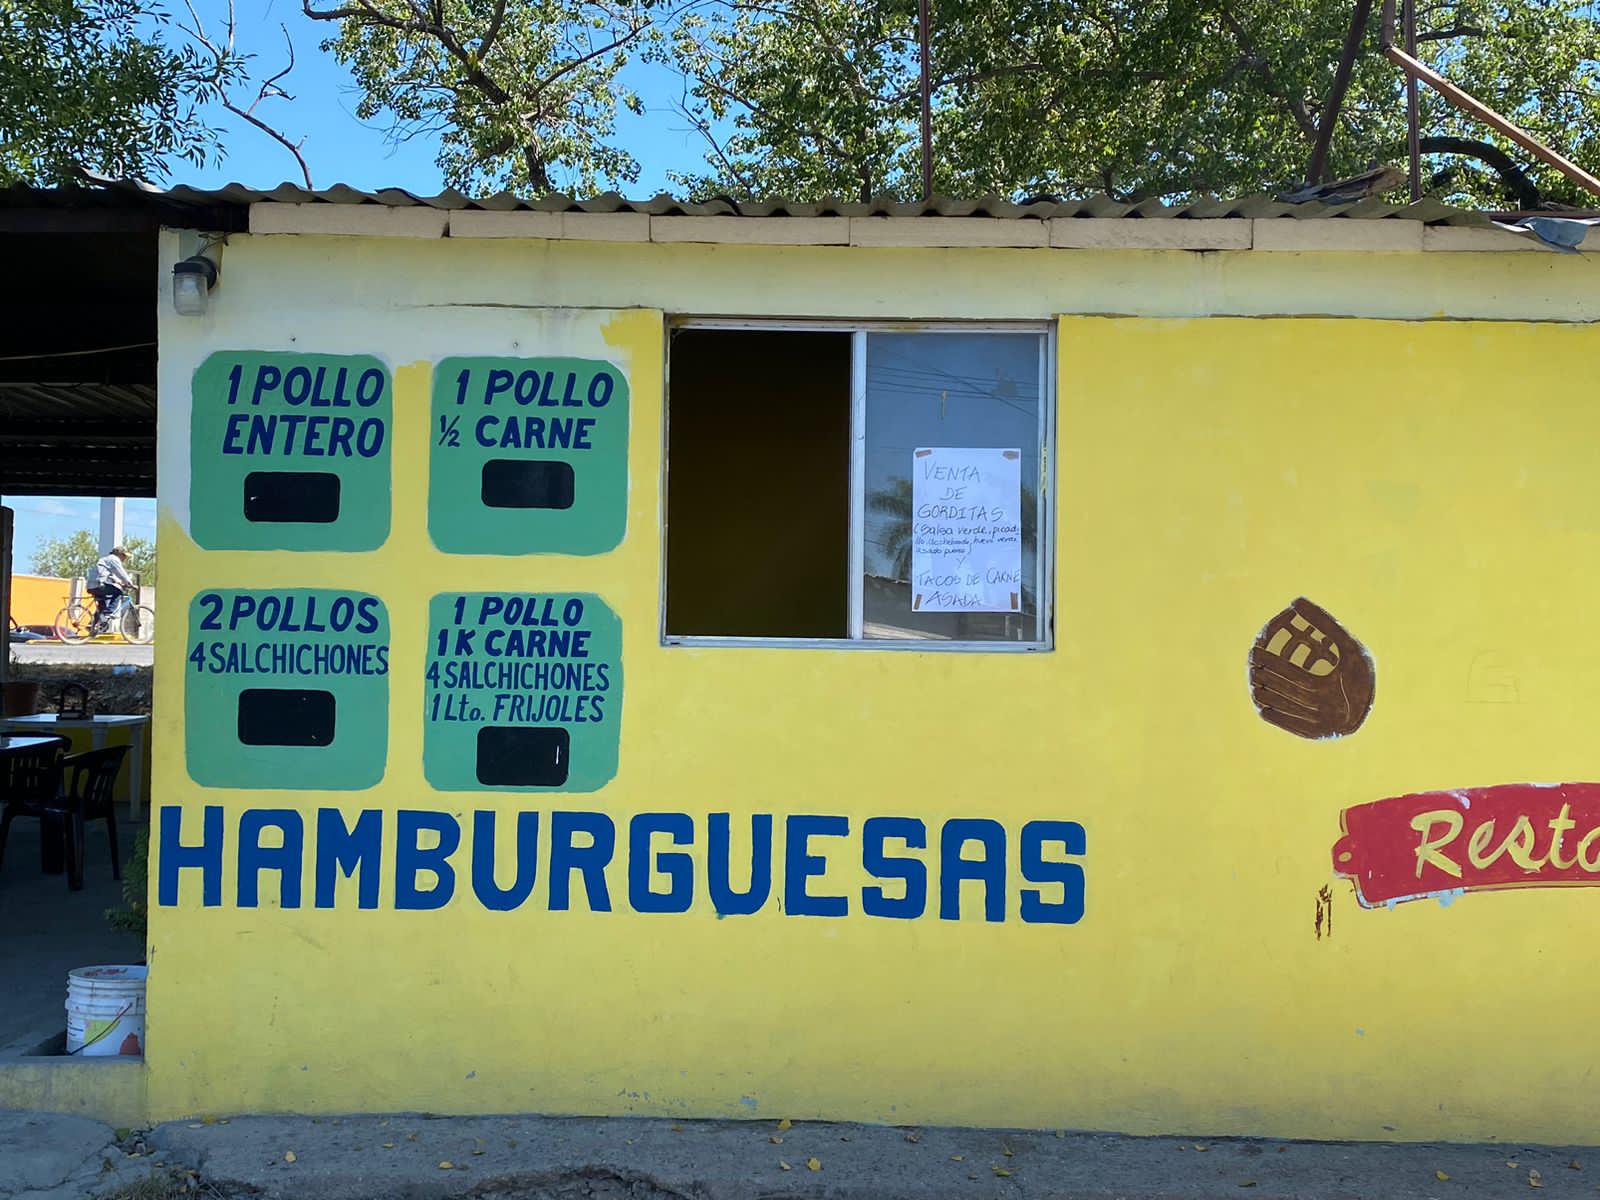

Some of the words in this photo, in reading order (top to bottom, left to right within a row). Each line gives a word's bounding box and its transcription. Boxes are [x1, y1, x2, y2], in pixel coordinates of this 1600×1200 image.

[227, 364, 243, 405] 1
[251, 364, 385, 408] POLLO
[456, 368, 471, 405] 1
[483, 368, 614, 408] POLLO
[222, 413, 385, 458] ENTERO
[475, 414, 596, 450] CARNE
[924, 461, 980, 482] VENTA
[940, 486, 967, 501] DE
[917, 504, 1003, 522] GORDITAS
[919, 570, 961, 586] TACOS
[966, 574, 980, 586] DE
[986, 568, 1020, 584] CARNE
[200, 593, 223, 632] 2
[229, 595, 379, 634] POLLOS
[454, 596, 466, 625] 1
[478, 596, 584, 627] POLLO
[924, 591, 981, 607] ASADA
[484, 629, 592, 658] CARNE
[492, 694, 605, 723] FRIJOLES
[158, 805, 1086, 925] HAMBURGUESAS
